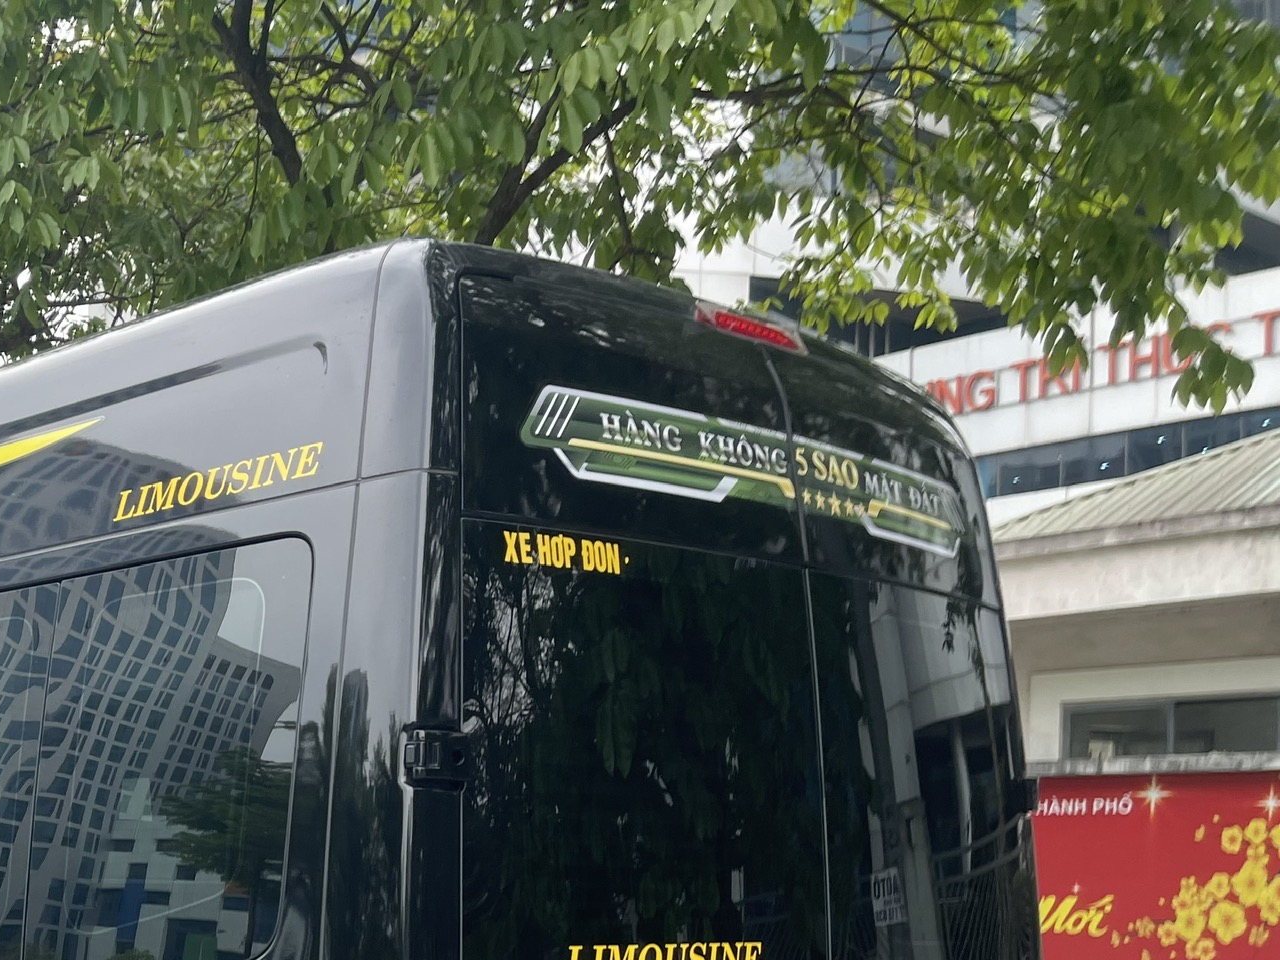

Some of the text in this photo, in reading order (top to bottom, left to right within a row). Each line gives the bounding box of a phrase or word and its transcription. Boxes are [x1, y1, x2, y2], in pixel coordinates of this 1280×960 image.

[926, 370, 996, 416] NG
[600, 410, 683, 452] HÀNG
[698, 434, 788, 474] KHÔNG
[795, 447, 809, 476] 5
[812, 449, 859, 490] SAO
[113, 441, 323, 522] LIMOUSINE
[503, 530, 533, 564] XE
[1092, 791, 1134, 816] PHỐ
